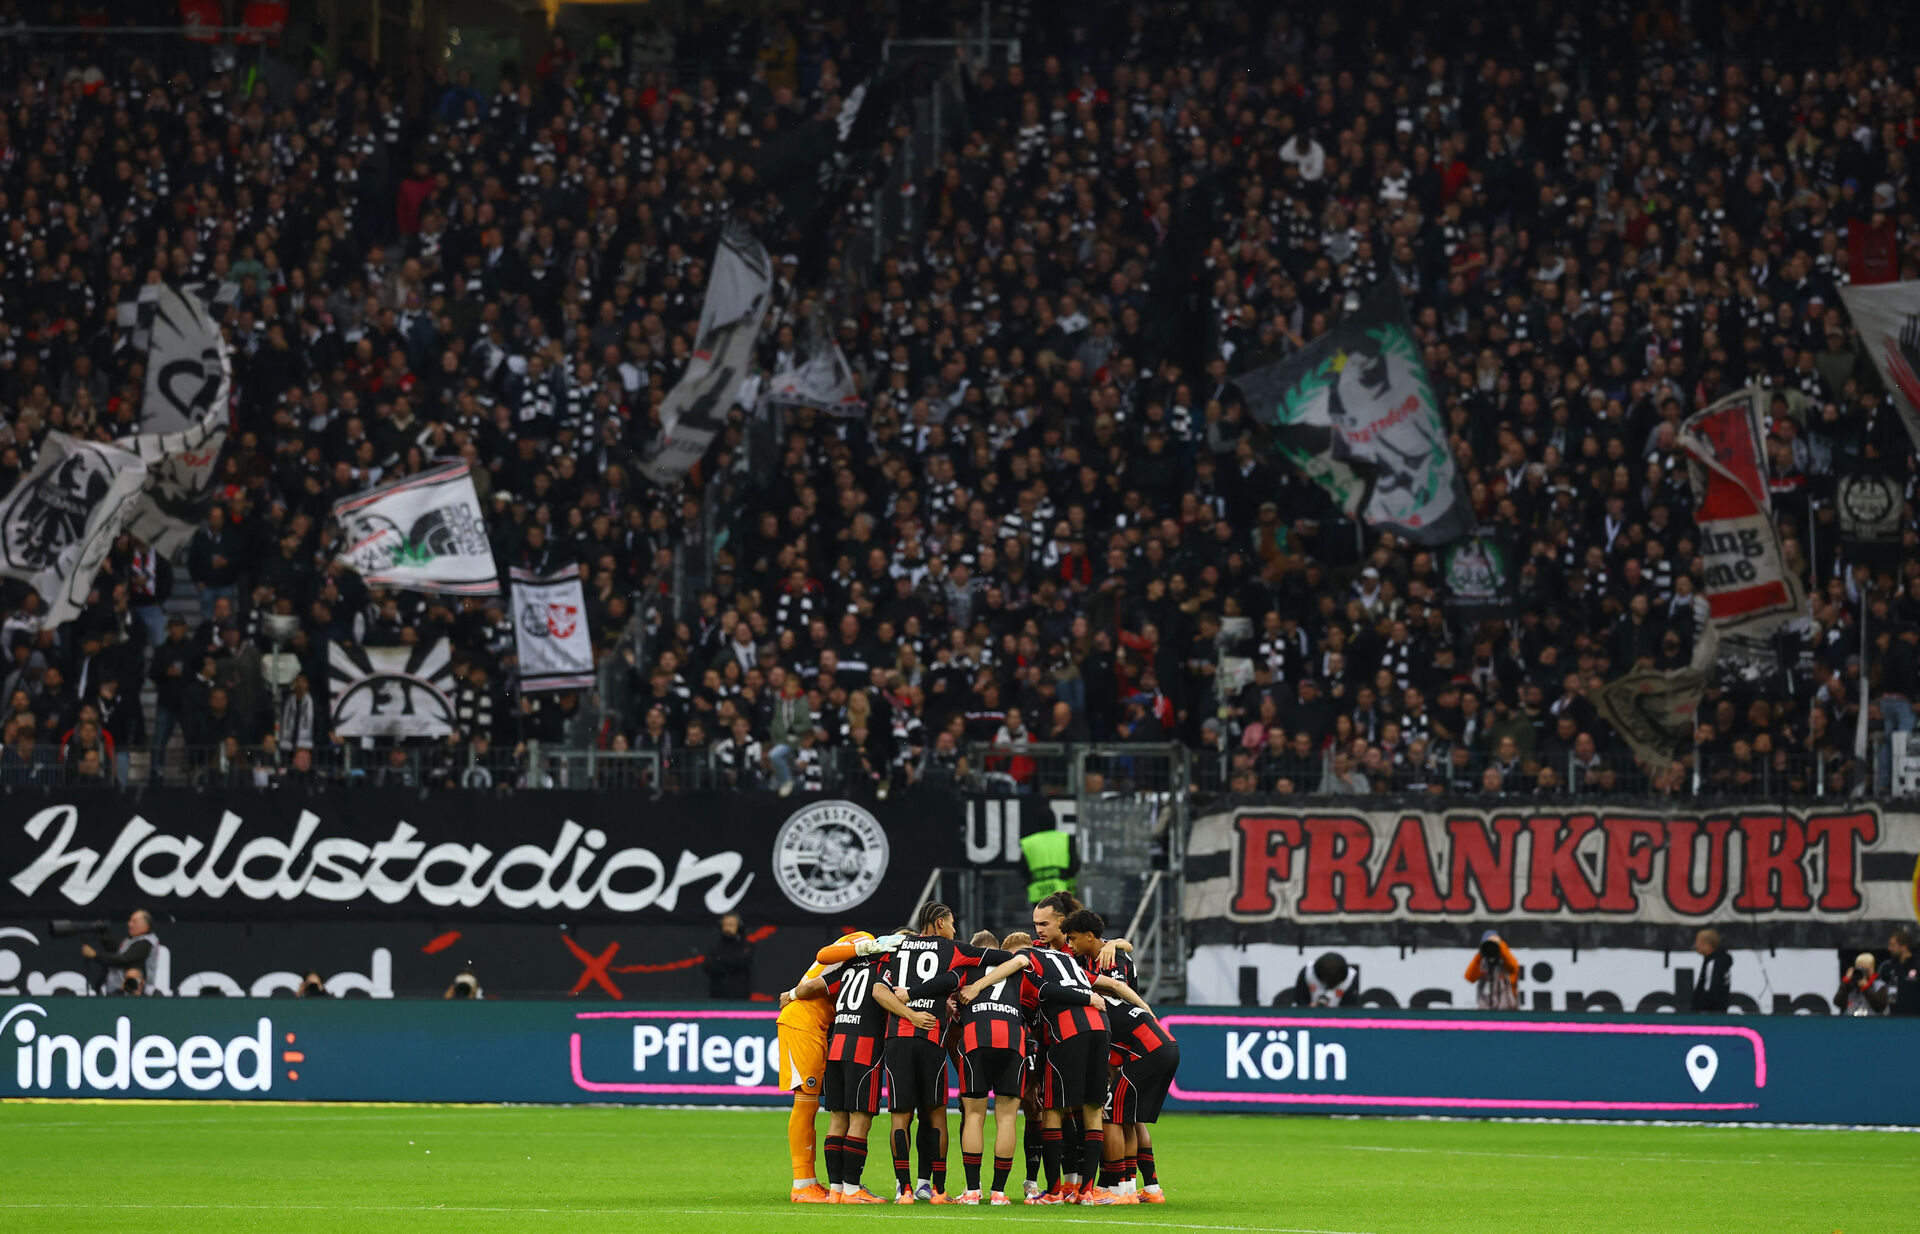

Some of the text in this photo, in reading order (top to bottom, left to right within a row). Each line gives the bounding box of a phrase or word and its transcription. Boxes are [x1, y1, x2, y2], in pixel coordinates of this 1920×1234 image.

[10, 804, 754, 914] Waldstadion
[1232, 809, 1878, 916] FRANKFURT
[901, 941, 938, 950] BAHOYA
[836, 968, 870, 1013] 20
[897, 950, 939, 990] 19
[972, 1002, 1019, 1017] EINTRACHT
[14, 1006, 272, 1091] indeed
[1226, 1030, 1347, 1080] Köln
